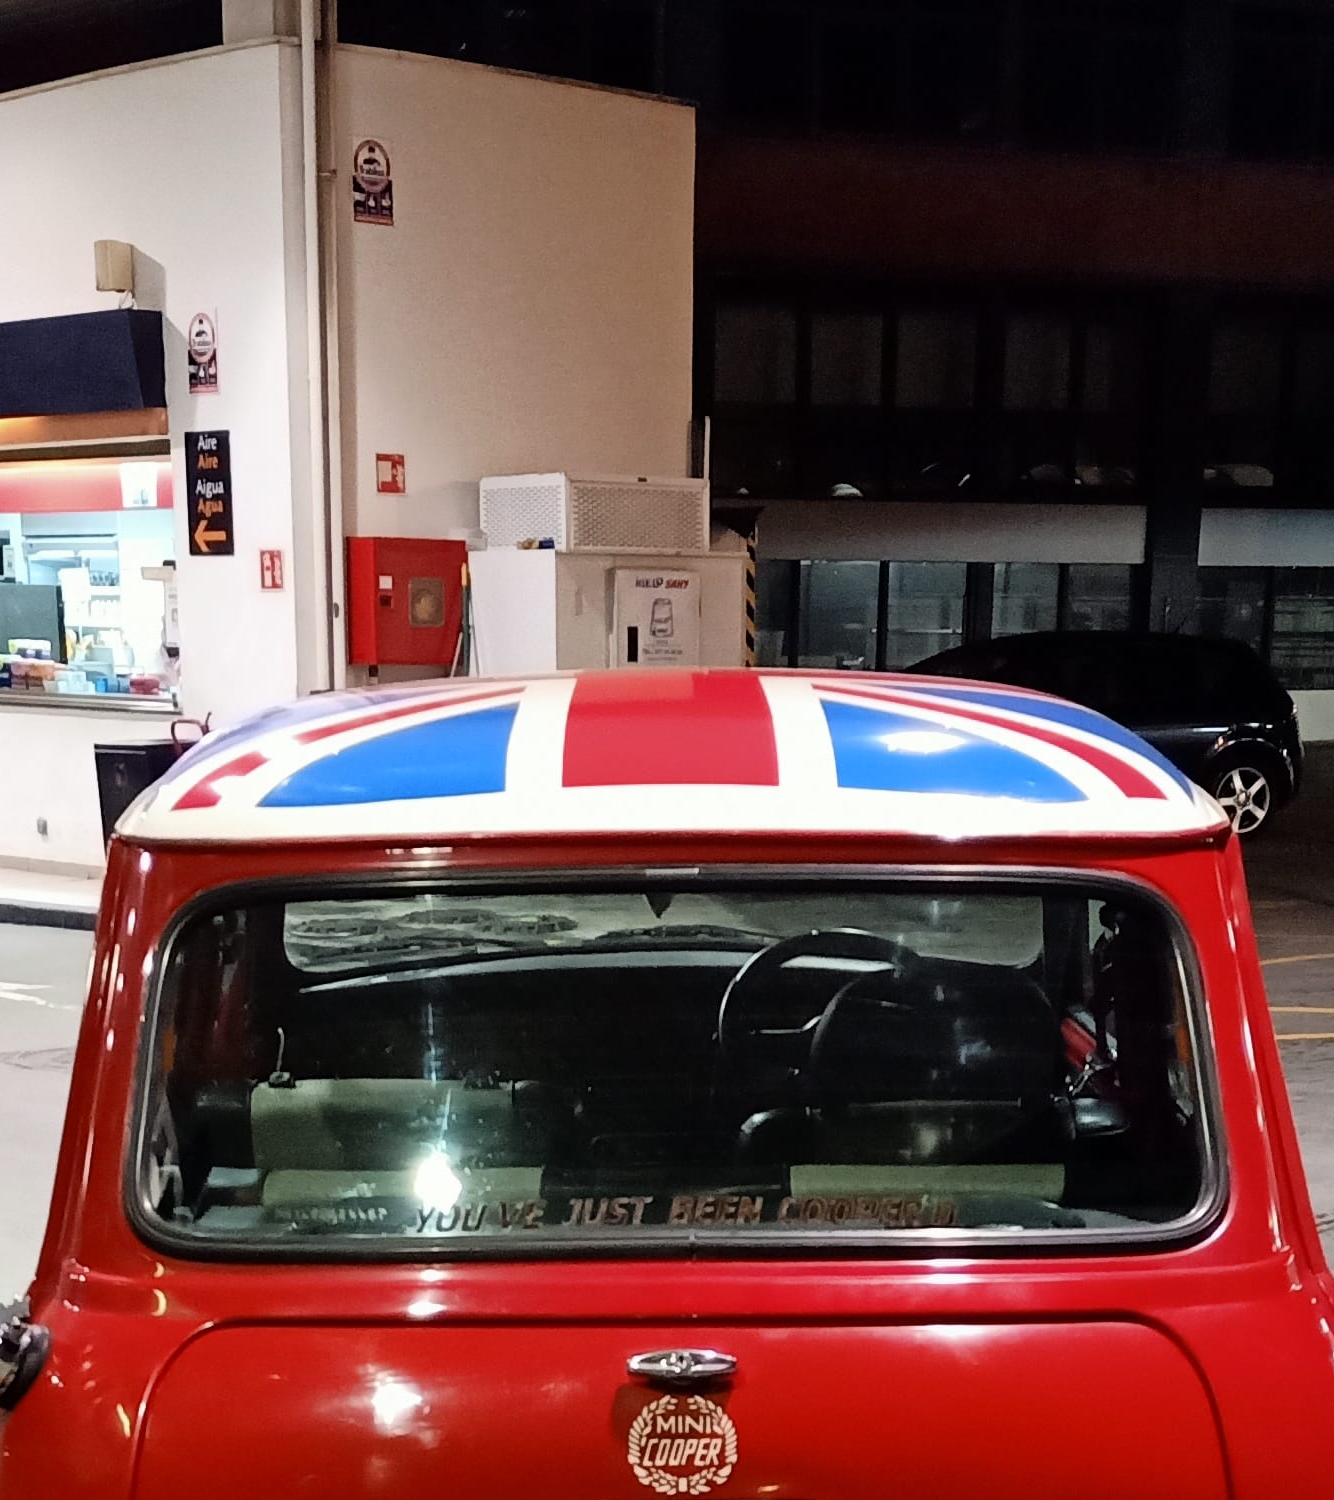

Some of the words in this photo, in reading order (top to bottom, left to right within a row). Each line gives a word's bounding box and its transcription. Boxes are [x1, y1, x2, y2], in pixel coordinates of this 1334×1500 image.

[197, 434, 218, 451] Aire
[197, 453, 219, 470] Aire
[195, 479, 224, 499] Aigua
[197, 498, 223, 518] Agua
[417, 1200, 545, 1233] YOUVE
[563, 1196, 643, 1226] JUST
[669, 1196, 763, 1225] BEEN
[656, 1415, 712, 1434] MINI
[643, 1438, 722, 1467] COOPER
